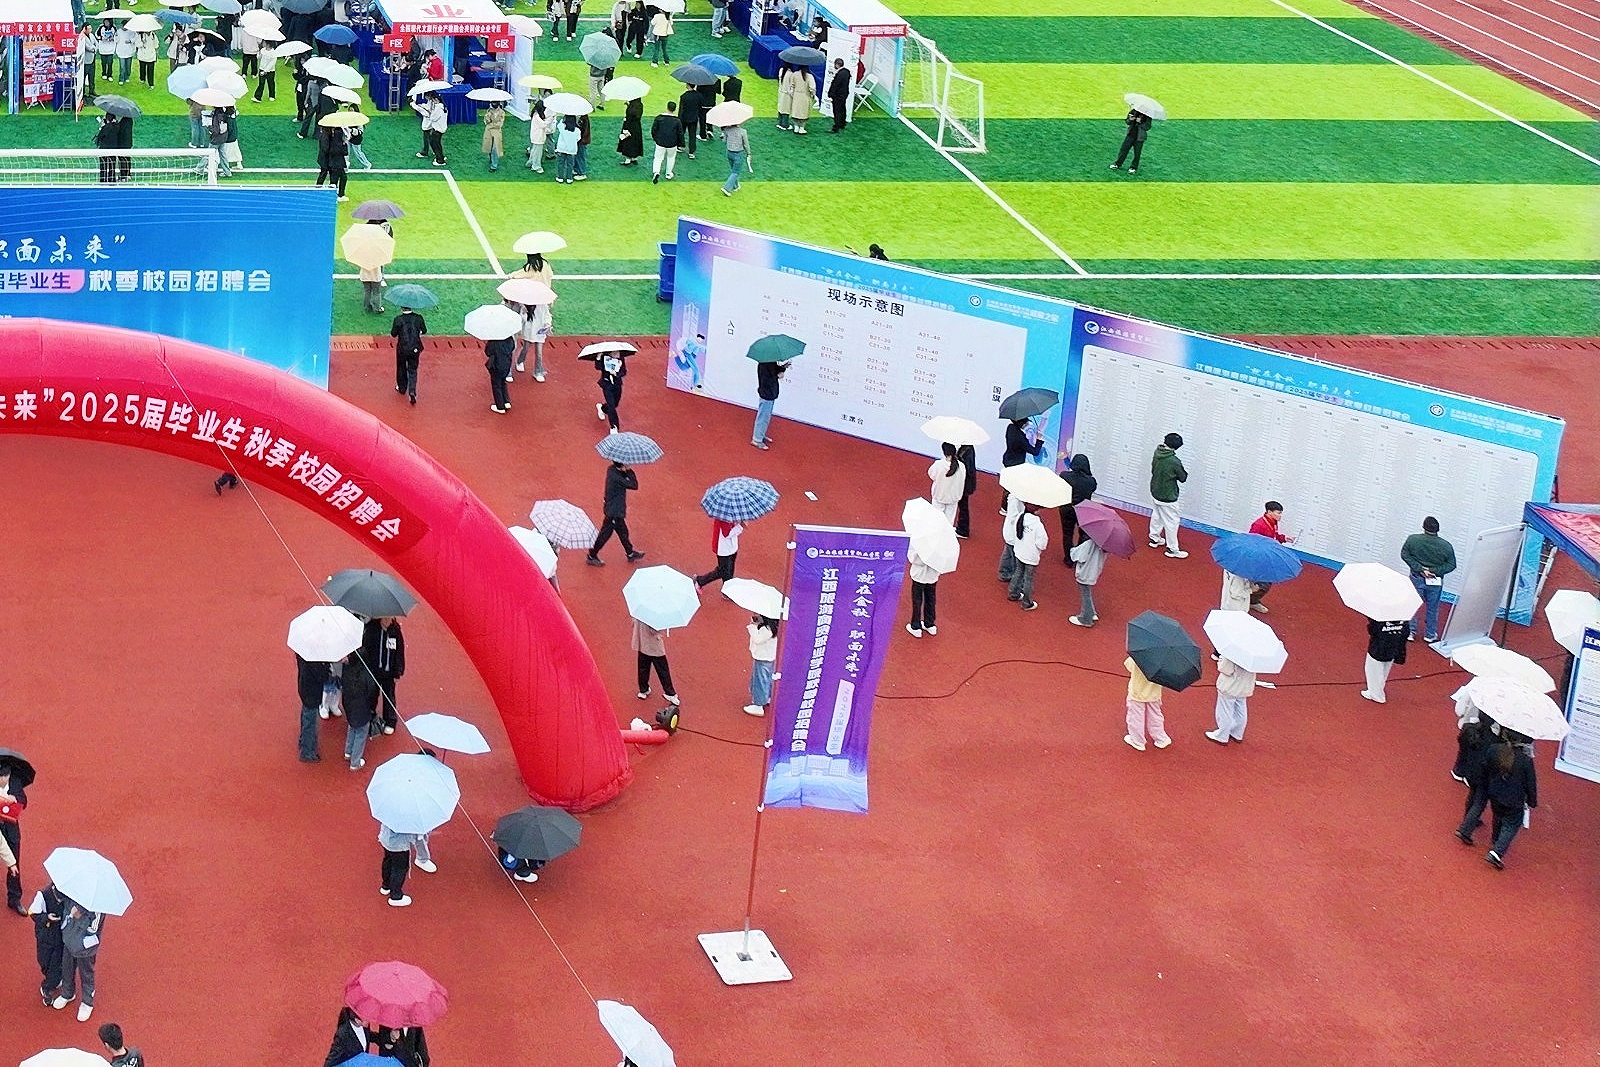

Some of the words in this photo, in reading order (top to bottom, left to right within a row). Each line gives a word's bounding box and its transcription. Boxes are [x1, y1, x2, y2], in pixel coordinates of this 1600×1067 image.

[61, 38, 75, 48] E区
[390, 39, 403, 48] F区
[494, 39, 509, 49] G区
[89, 269, 271, 293] 秋季校园招聘会
[827, 288, 905, 317] 现场示意图
